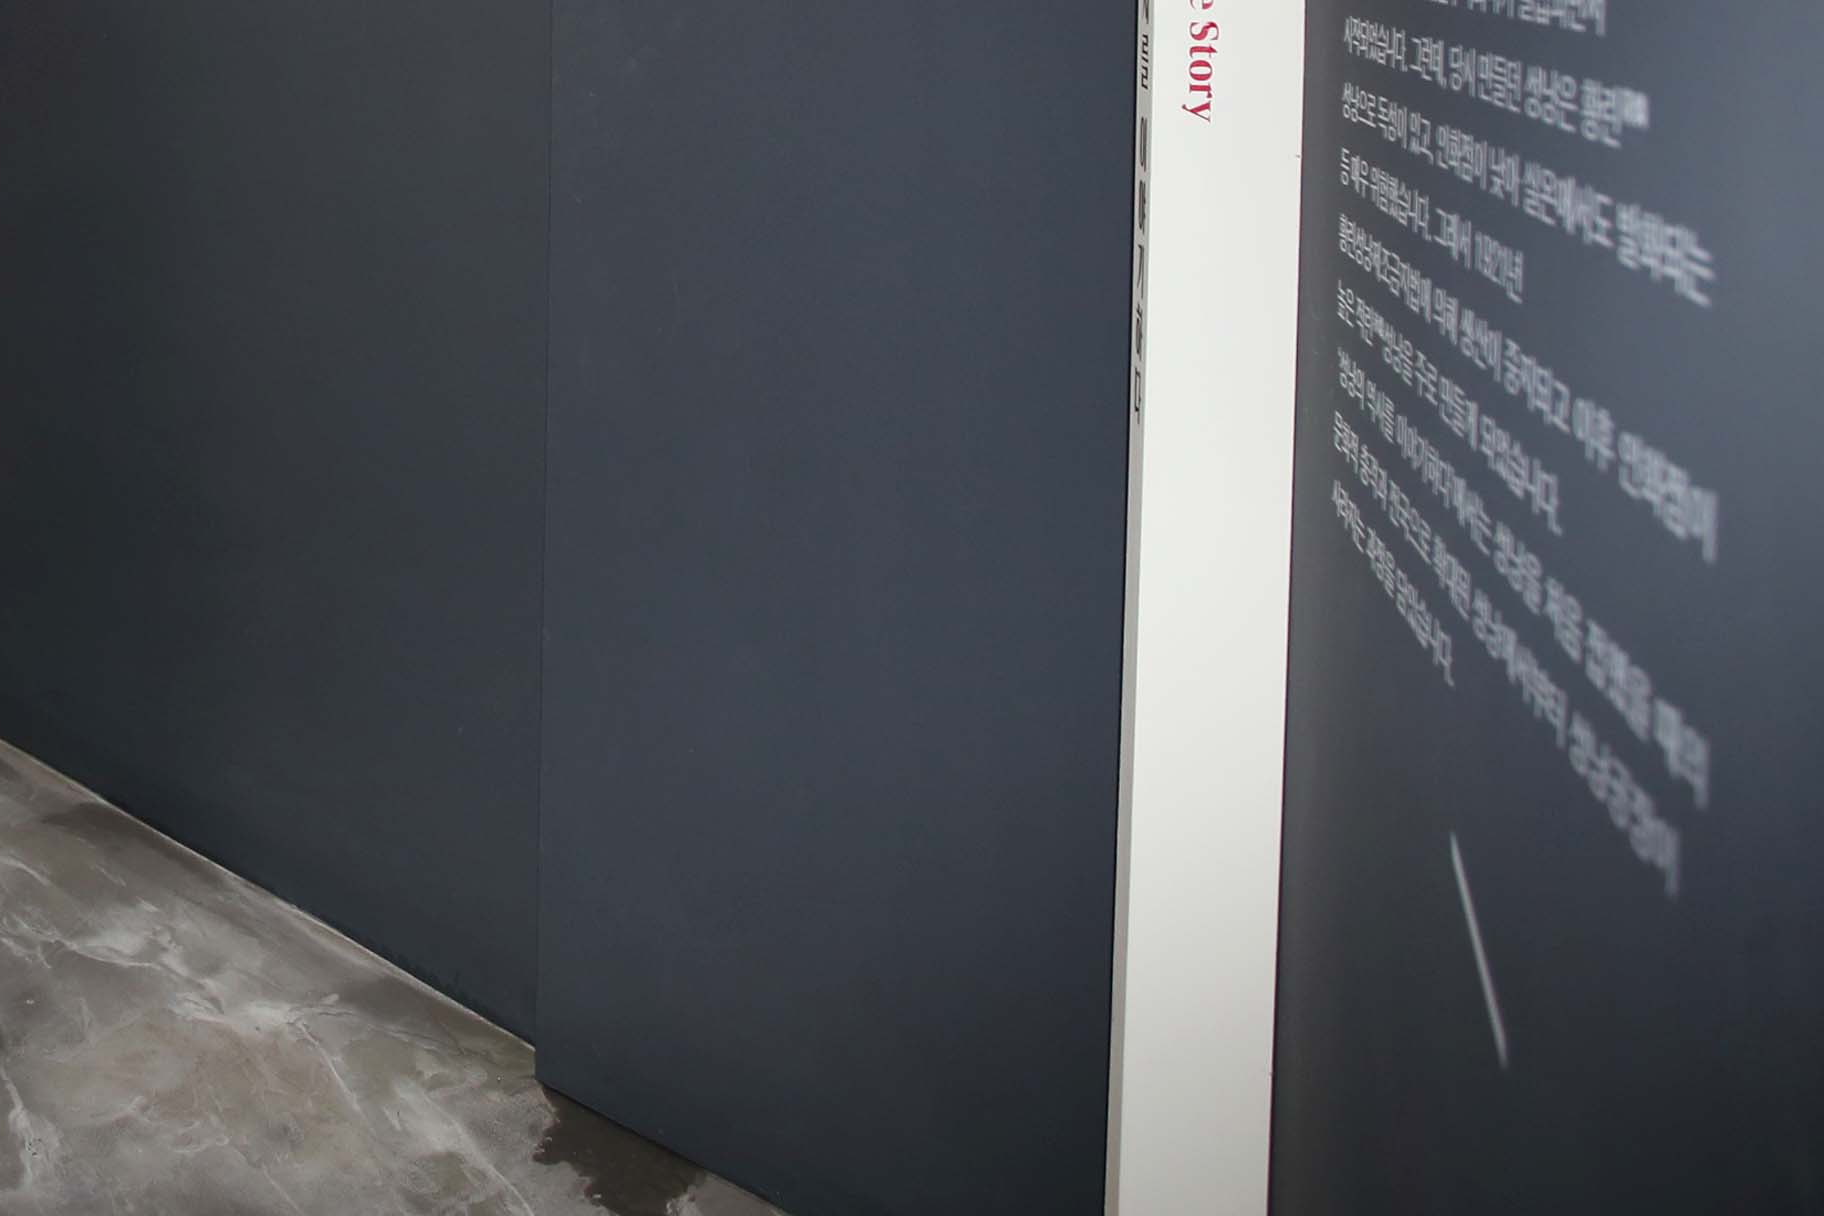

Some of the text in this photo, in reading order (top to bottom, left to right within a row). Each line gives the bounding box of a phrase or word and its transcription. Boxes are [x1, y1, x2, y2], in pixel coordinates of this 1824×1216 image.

[1181, 20, 1220, 123] Story
[1343, 14, 1410, 74] 시작되었습니다.
[1448, 44, 1478, 98] 당시
[1477, 52, 1523, 114] 만들던
[1523, 65, 1579, 133] 성냥은
[1340, 146, 1352, 187] 등
[1350, 154, 1371, 198] 매우
[1368, 165, 1433, 242] 위험했습니다.
[1433, 206, 1473, 270] 그래서
[1342, 81, 1378, 129] 성냥으로
[1376, 95, 1409, 150] 독성이
[1488, 146, 1522, 208] 낮아
[1337, 278, 1356, 329] 높은
[1414, 349, 1440, 407] 주로
[1438, 374, 1480, 451] 만들게
[1432, 286, 1460, 346] 의해
[1459, 307, 1503, 383] 생산이
[1503, 337, 1571, 434] 중지되고
[1331, 478, 1367, 554] 사라지는
[1365, 526, 1397, 600] 과정을
[1333, 409, 1360, 474] 문화적
[1359, 443, 1389, 512] 충격과
[1388, 478, 1433, 566] 전국으로
[1366, 379, 1396, 445] 역사를
[1493, 521, 1544, 615] 성냥을
[1544, 576, 1584, 662] 처음
